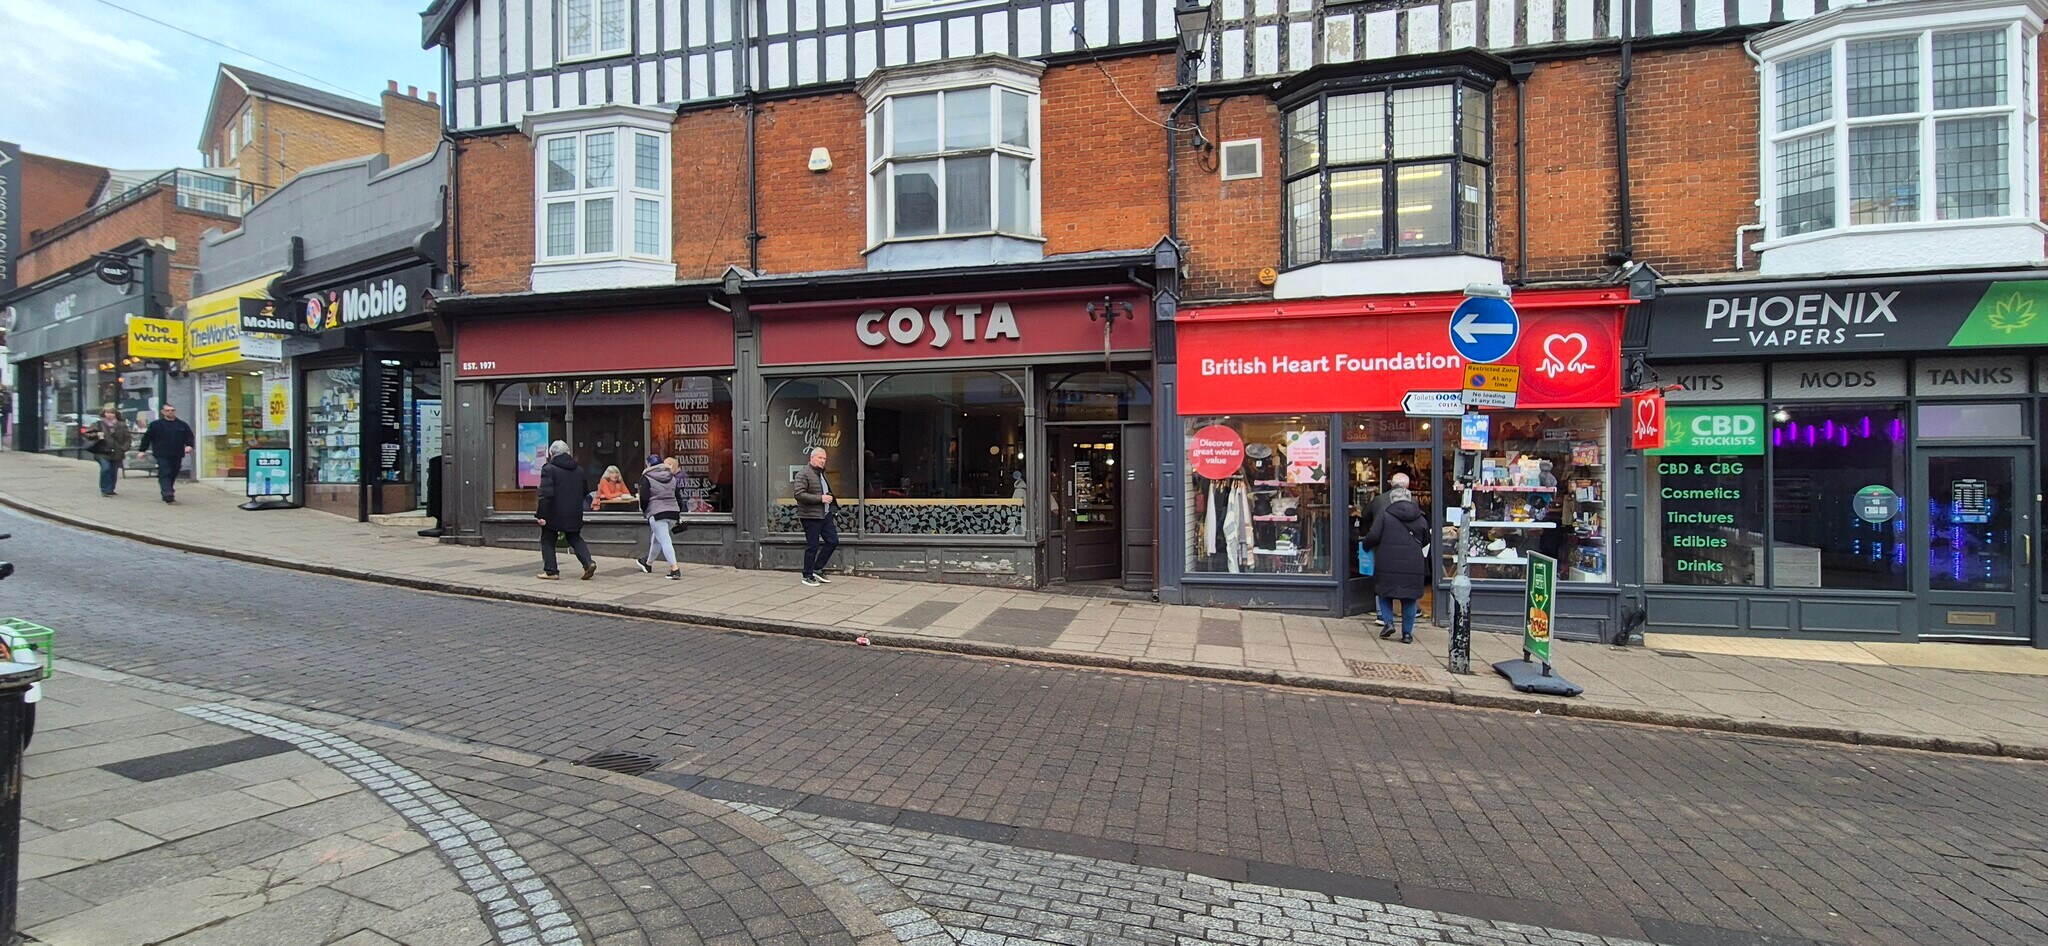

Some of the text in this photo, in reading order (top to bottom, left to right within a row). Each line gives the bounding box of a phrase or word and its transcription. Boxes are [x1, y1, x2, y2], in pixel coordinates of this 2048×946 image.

[342, 278, 407, 323] Mobile
[1705, 291, 1901, 329] PHOENIX
[143, 323, 170, 334] The
[243, 315, 295, 331] Mobile
[856, 302, 1021, 348] COSTA
[133, 332, 179, 345] Works
[1749, 328, 1847, 347] VAPERS
[463, 361, 496, 370] EST. 1971
[1201, 351, 1460, 377] British Heart Foundation
[1467, 365, 1500, 374] Restricted
[1800, 371, 1877, 389] MODS
[1927, 366, 2014, 386] TANKS
[1677, 375, 1724, 391] KITS
[1483, 392, 1506, 400] loading
[674, 398, 709, 410] COFFEE
[674, 413, 709, 423] ICED COLD
[784, 408, 822, 437] Freshly
[674, 423, 709, 435] DRINKS
[1691, 415, 1756, 436] CBD
[674, 439, 709, 450] PANINIS
[802, 429, 841, 455] Ground
[1199, 439, 1234, 448] Discover
[1691, 436, 1756, 446] STOCKISTS
[675, 454, 709, 465] TOASTED
[1193, 449, 1241, 458] great winter
[1205, 457, 1227, 465] value
[1657, 463, 1744, 475] CBD & CBG
[702, 477, 711, 488] &
[1660, 488, 1740, 499] Cosmetics
[1667, 512, 1734, 524] Tinctures
[1673, 536, 1727, 547] Edibles
[1677, 560, 1723, 571] Drinks
